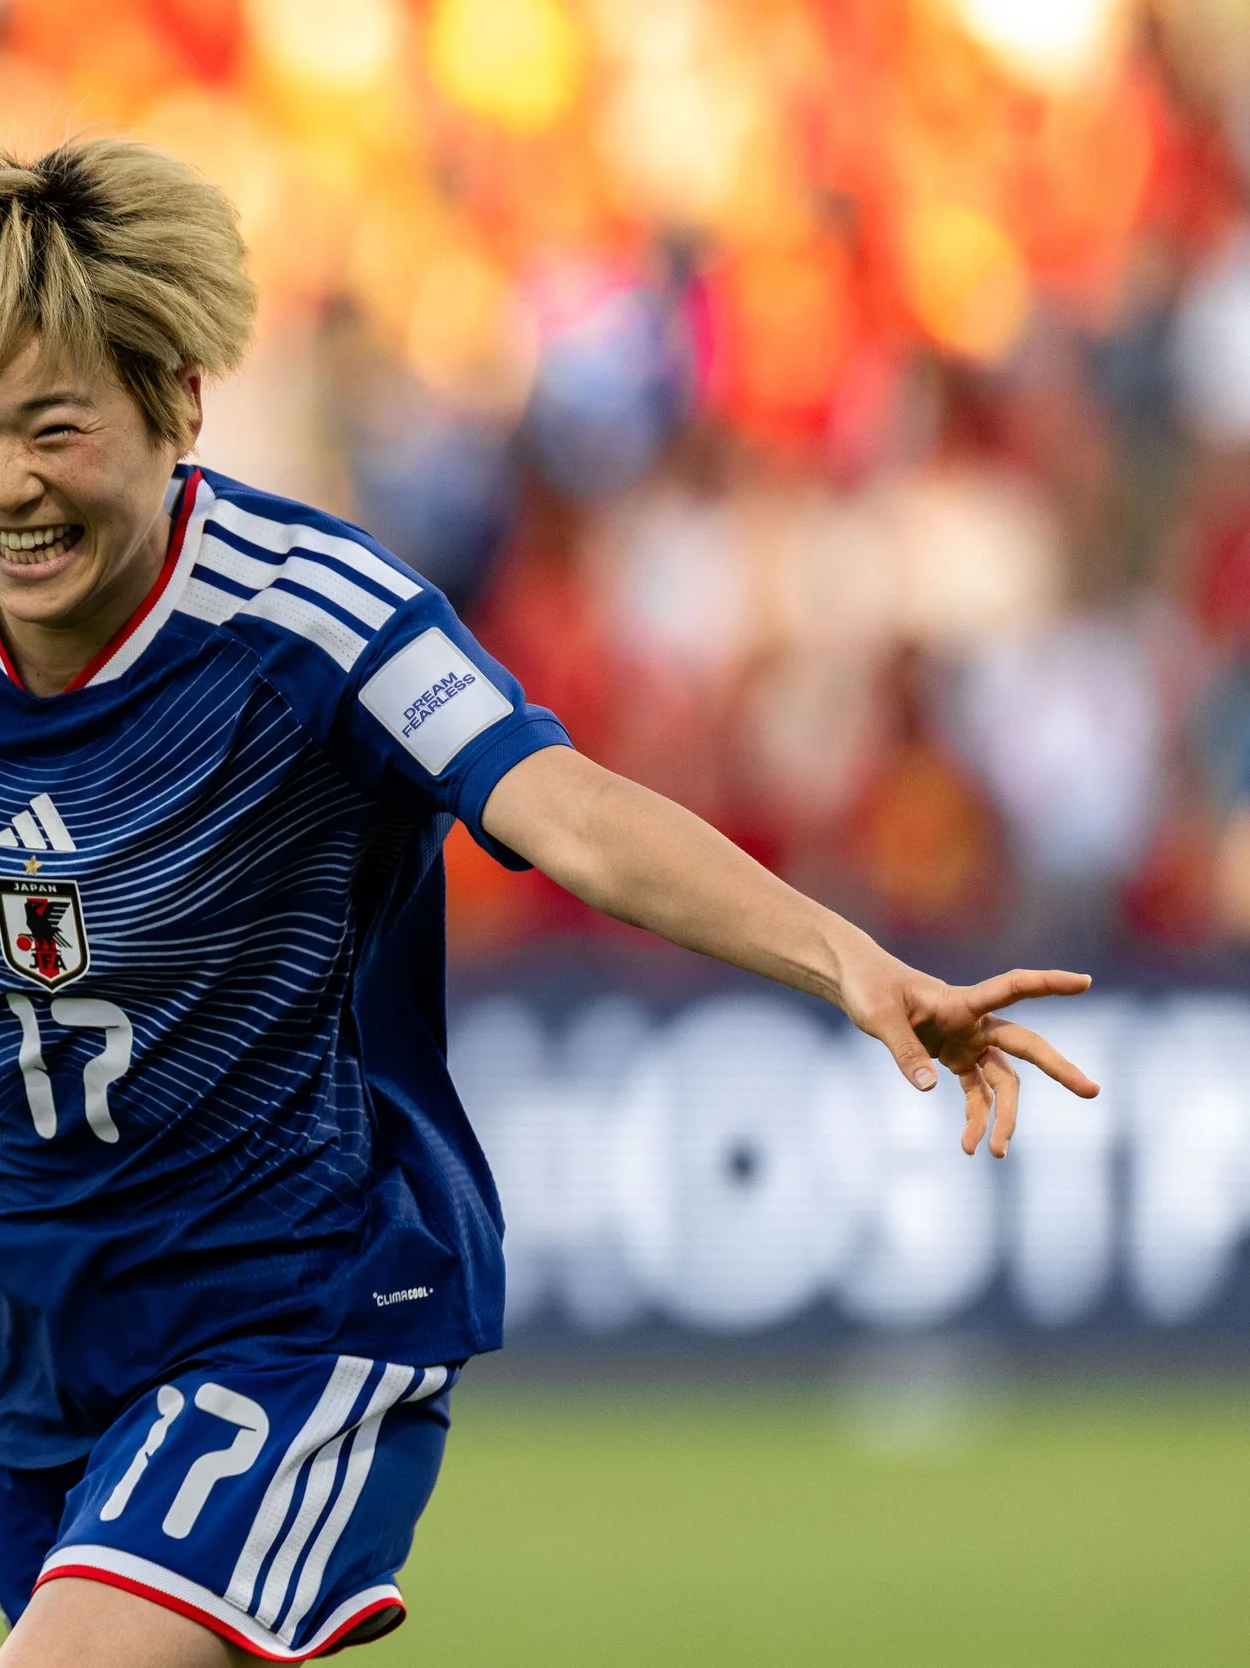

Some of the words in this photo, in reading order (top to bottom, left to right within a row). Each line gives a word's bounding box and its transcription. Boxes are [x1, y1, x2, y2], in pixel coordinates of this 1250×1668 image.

[401, 673, 476, 738] FEARLESS
[403, 671, 458, 721] DREAM
[13, 882, 57, 893] JAPAN
[29, 952, 68, 971] JFA
[6, 993, 134, 1143] 17
[100, 1382, 270, 1540] 17
